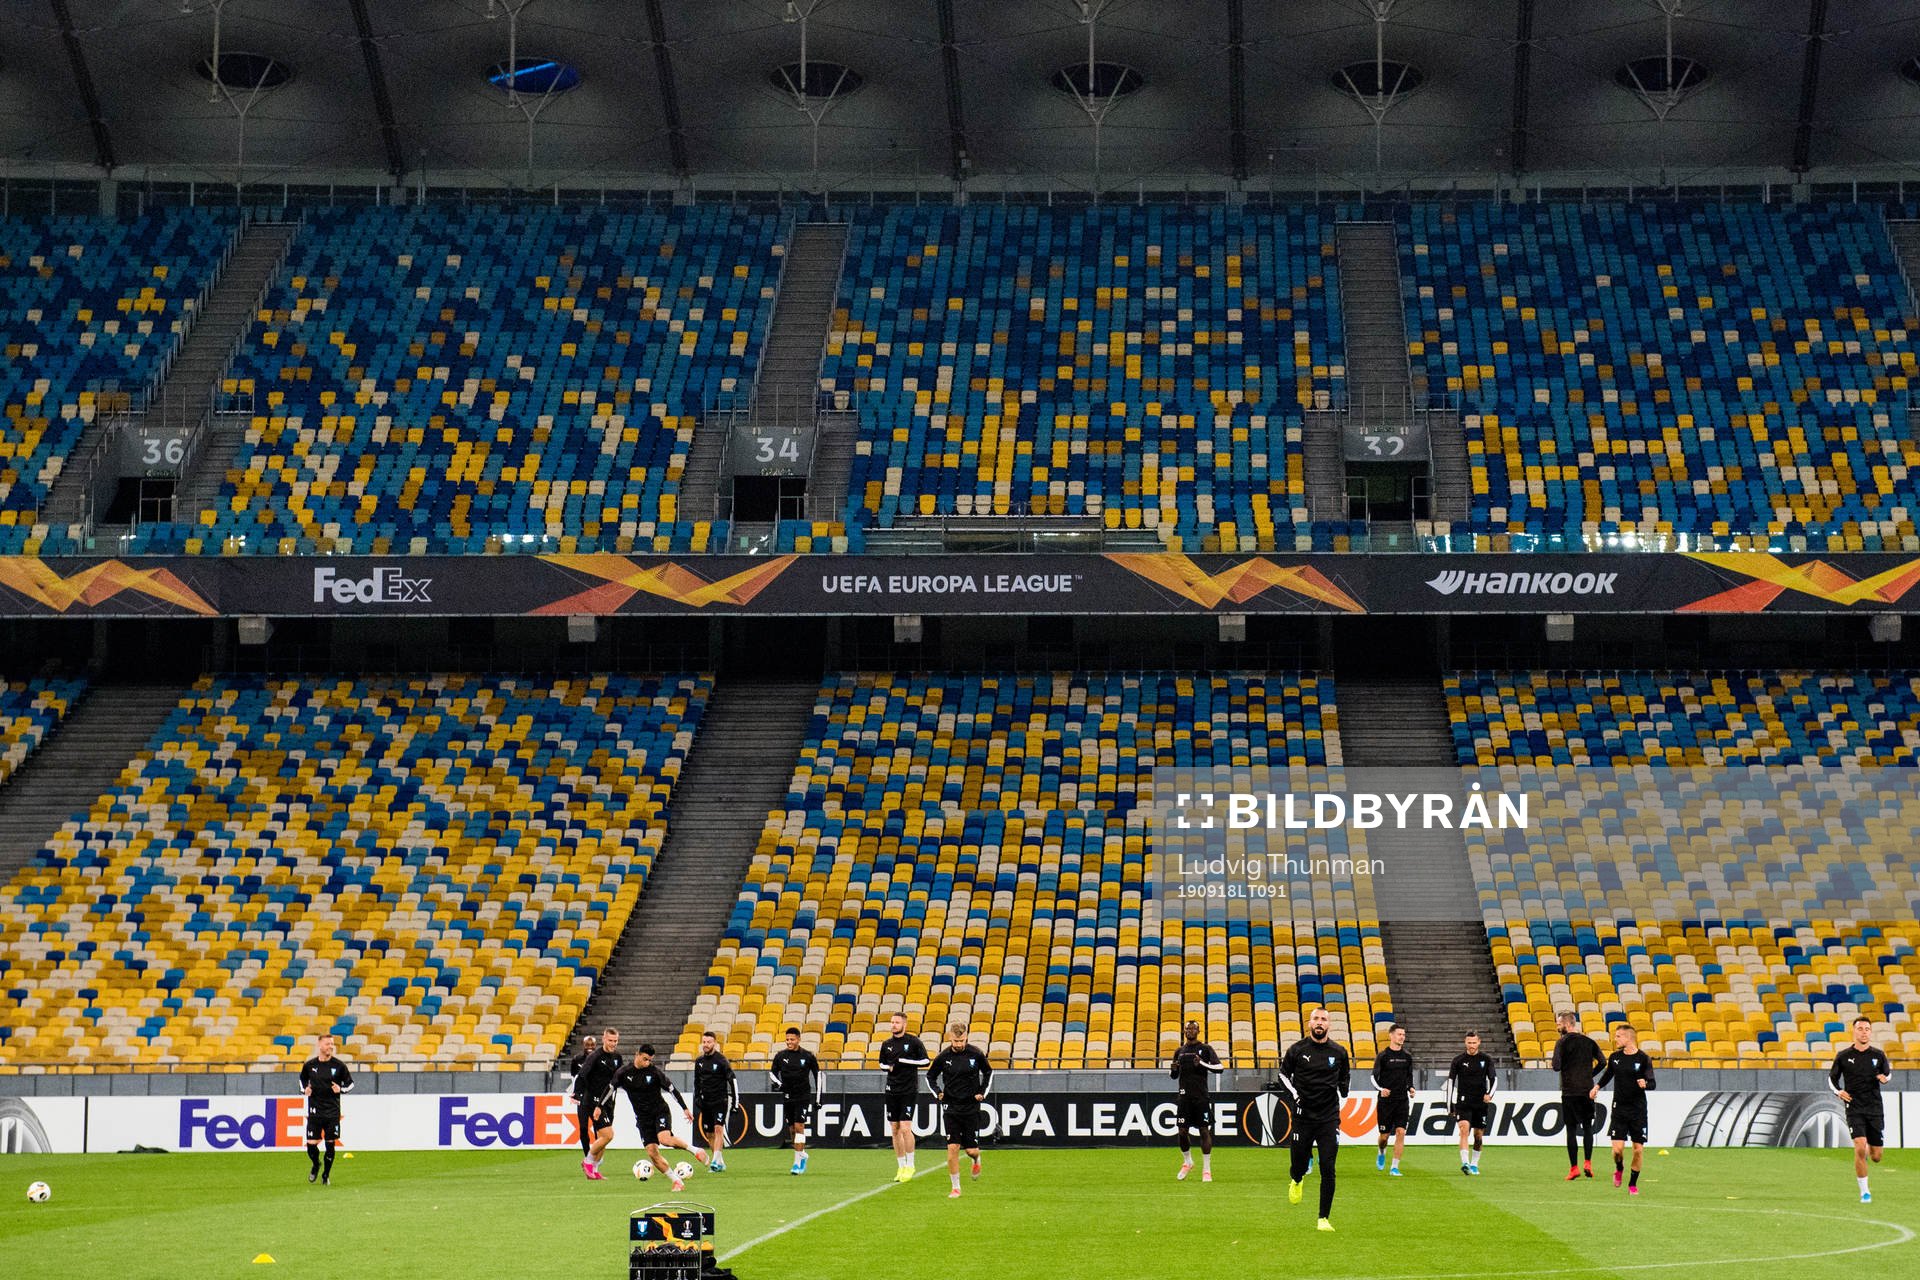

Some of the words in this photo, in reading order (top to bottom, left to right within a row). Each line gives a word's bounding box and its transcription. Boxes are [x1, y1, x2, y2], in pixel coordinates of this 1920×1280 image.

[142, 438, 184, 464] 36
[755, 437, 799, 463] 34
[314, 567, 432, 603] FedEx
[822, 575, 883, 593] UEFA
[888, 575, 978, 593] EUROPA
[983, 574, 1072, 593] LEAGUE
[1067, 1103, 1238, 1137] LEAGE
